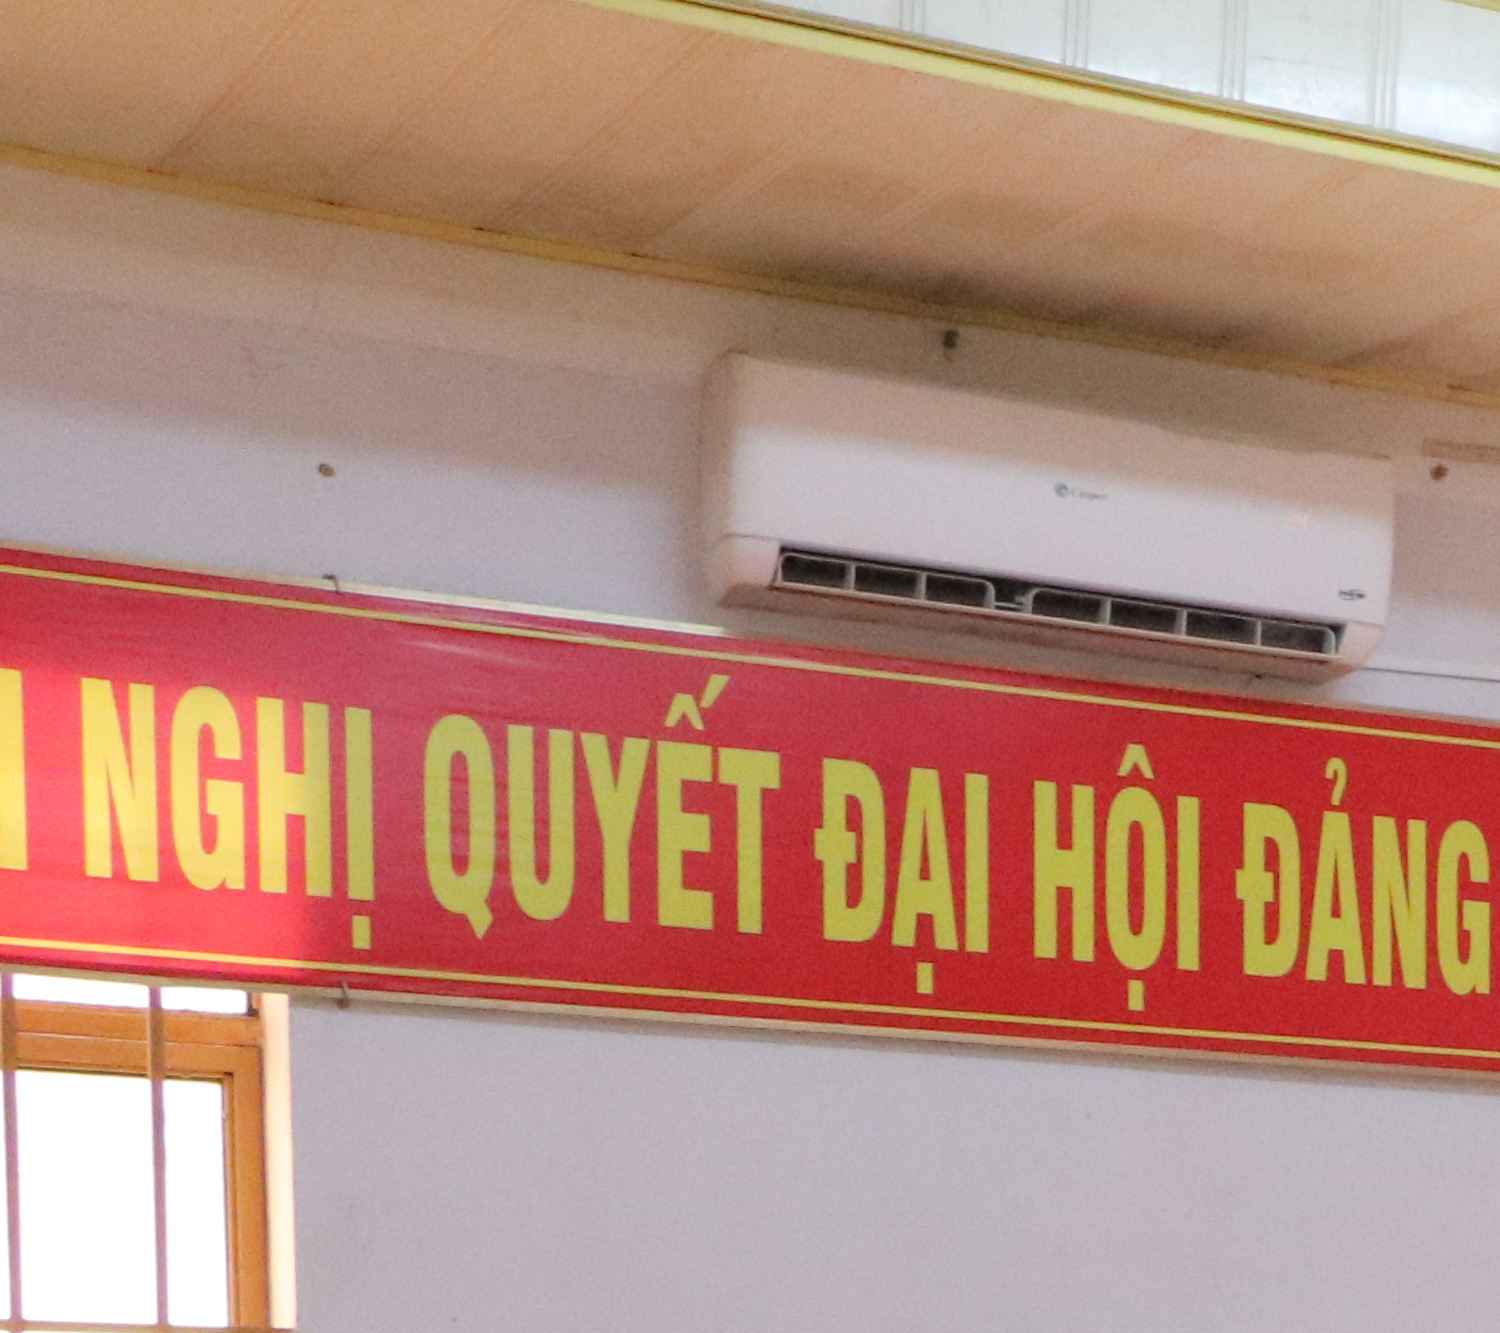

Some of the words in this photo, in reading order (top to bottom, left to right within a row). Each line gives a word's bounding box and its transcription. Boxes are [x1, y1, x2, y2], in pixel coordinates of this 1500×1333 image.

[81, 677, 374, 950] NGHỊ
[423, 674, 781, 941] QUYẾT
[814, 757, 989, 995] ĐẠI
[1033, 743, 1200, 1012] HỘI
[1234, 756, 1491, 996] ĐẢNG
